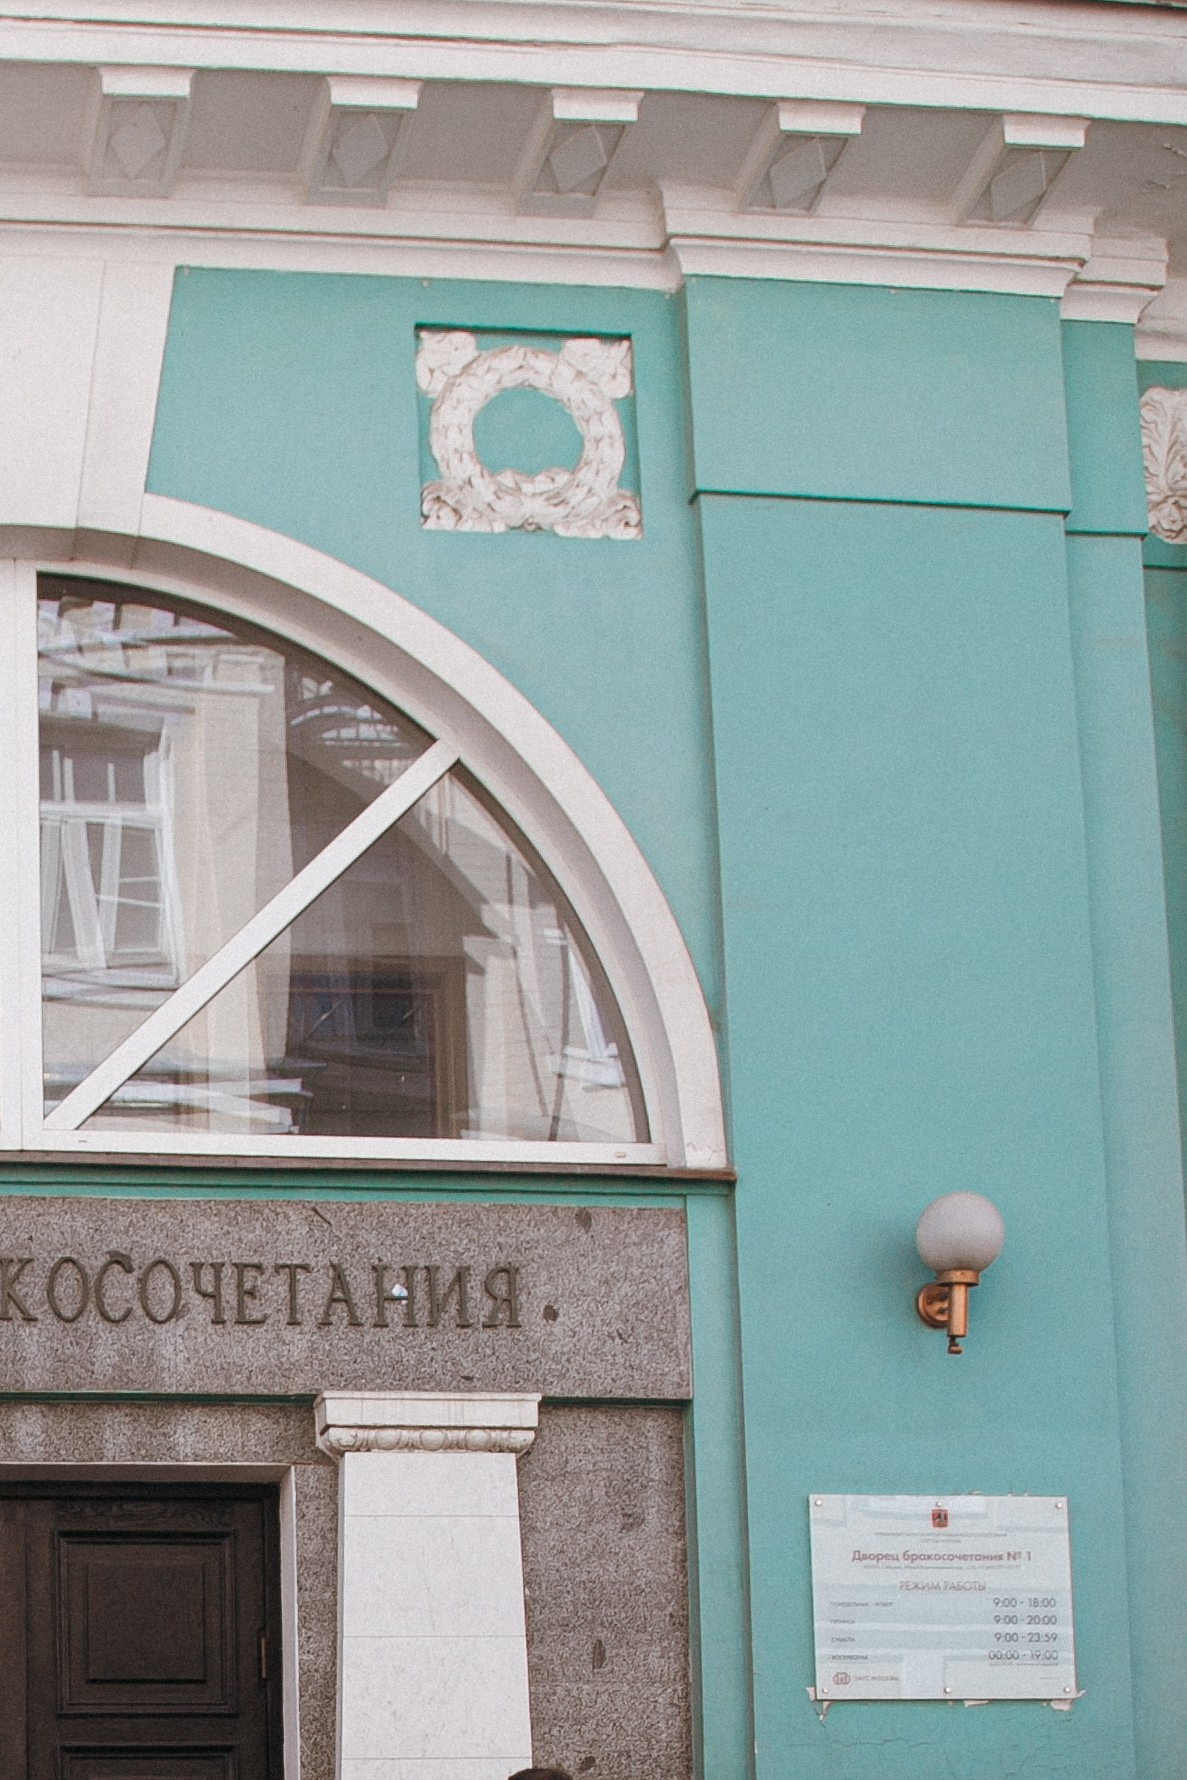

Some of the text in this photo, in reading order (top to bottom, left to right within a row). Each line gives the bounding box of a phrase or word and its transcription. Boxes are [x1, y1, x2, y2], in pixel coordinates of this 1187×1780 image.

[851, 1550, 900, 1563] Дворец
[902, 1549, 1004, 1563] бракосочетания
[1026, 1551, 1032, 1561] 1
[899, 1580, 987, 1591] РЕЖИМ РАБОТЫ
[993, 1597, 1018, 1608] 9:00
[1028, 1597, 1057, 1608] 18:00
[993, 1614, 1018, 1625] 9:00
[1026, 1614, 1058, 1626] 20:00
[994, 1632, 1019, 1643] 9:00
[1027, 1632, 1059, 1643] 23:59
[988, 1650, 1020, 1661] 00:00
[1029, 1650, 1059, 1661] 19:00
